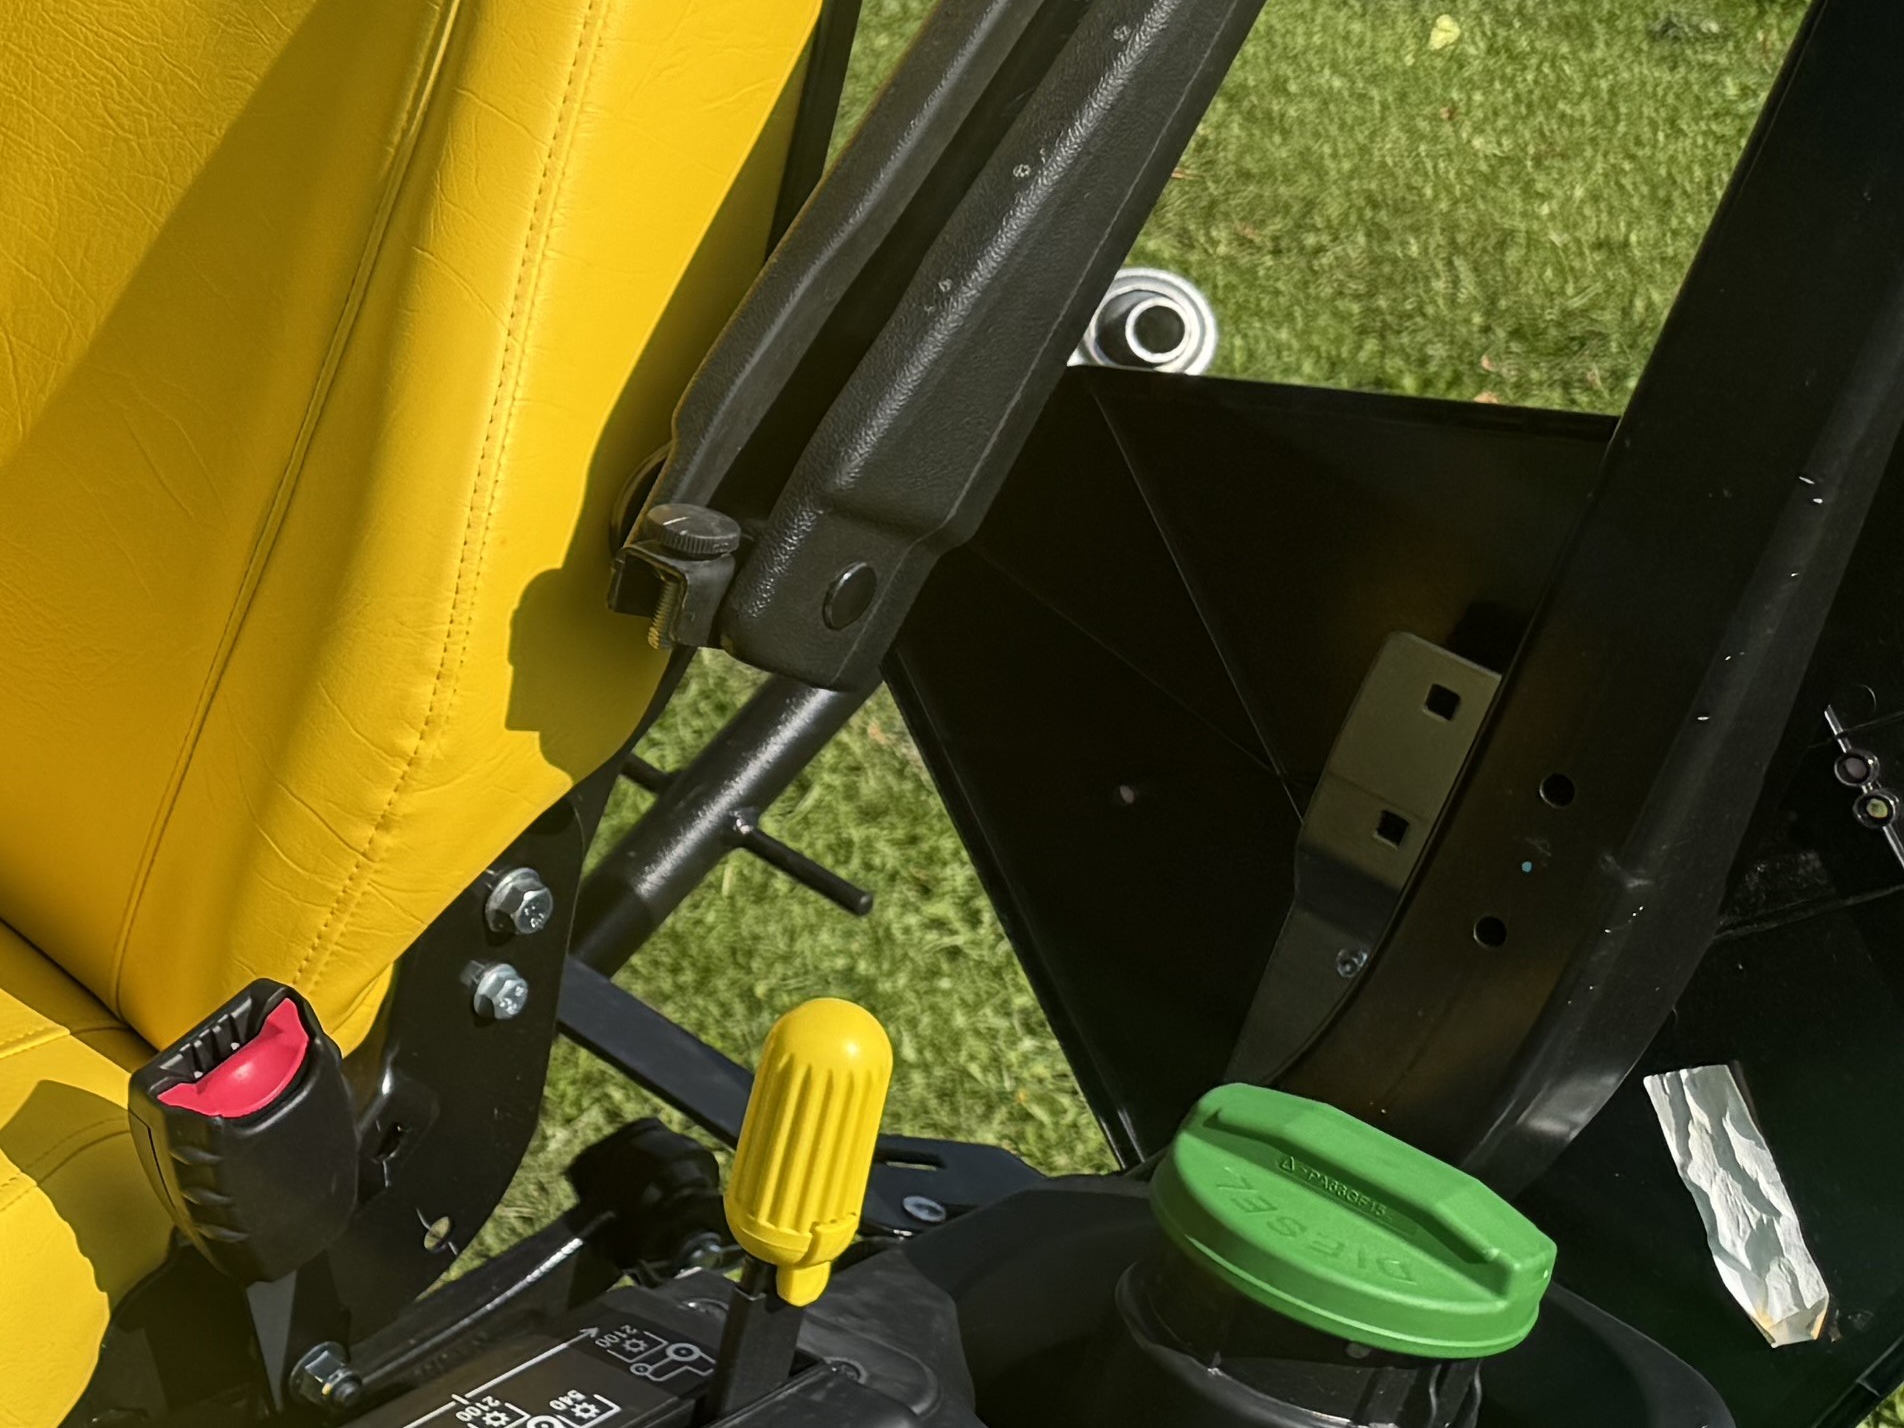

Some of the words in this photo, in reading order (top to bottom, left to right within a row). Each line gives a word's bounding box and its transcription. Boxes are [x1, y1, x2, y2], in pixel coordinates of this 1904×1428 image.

[1215, 1166, 1417, 1286] DIESEL
[595, 1324, 639, 1349] 2100
[454, 1394, 502, 1424] 2100
[549, 1387, 582, 1412] 540
